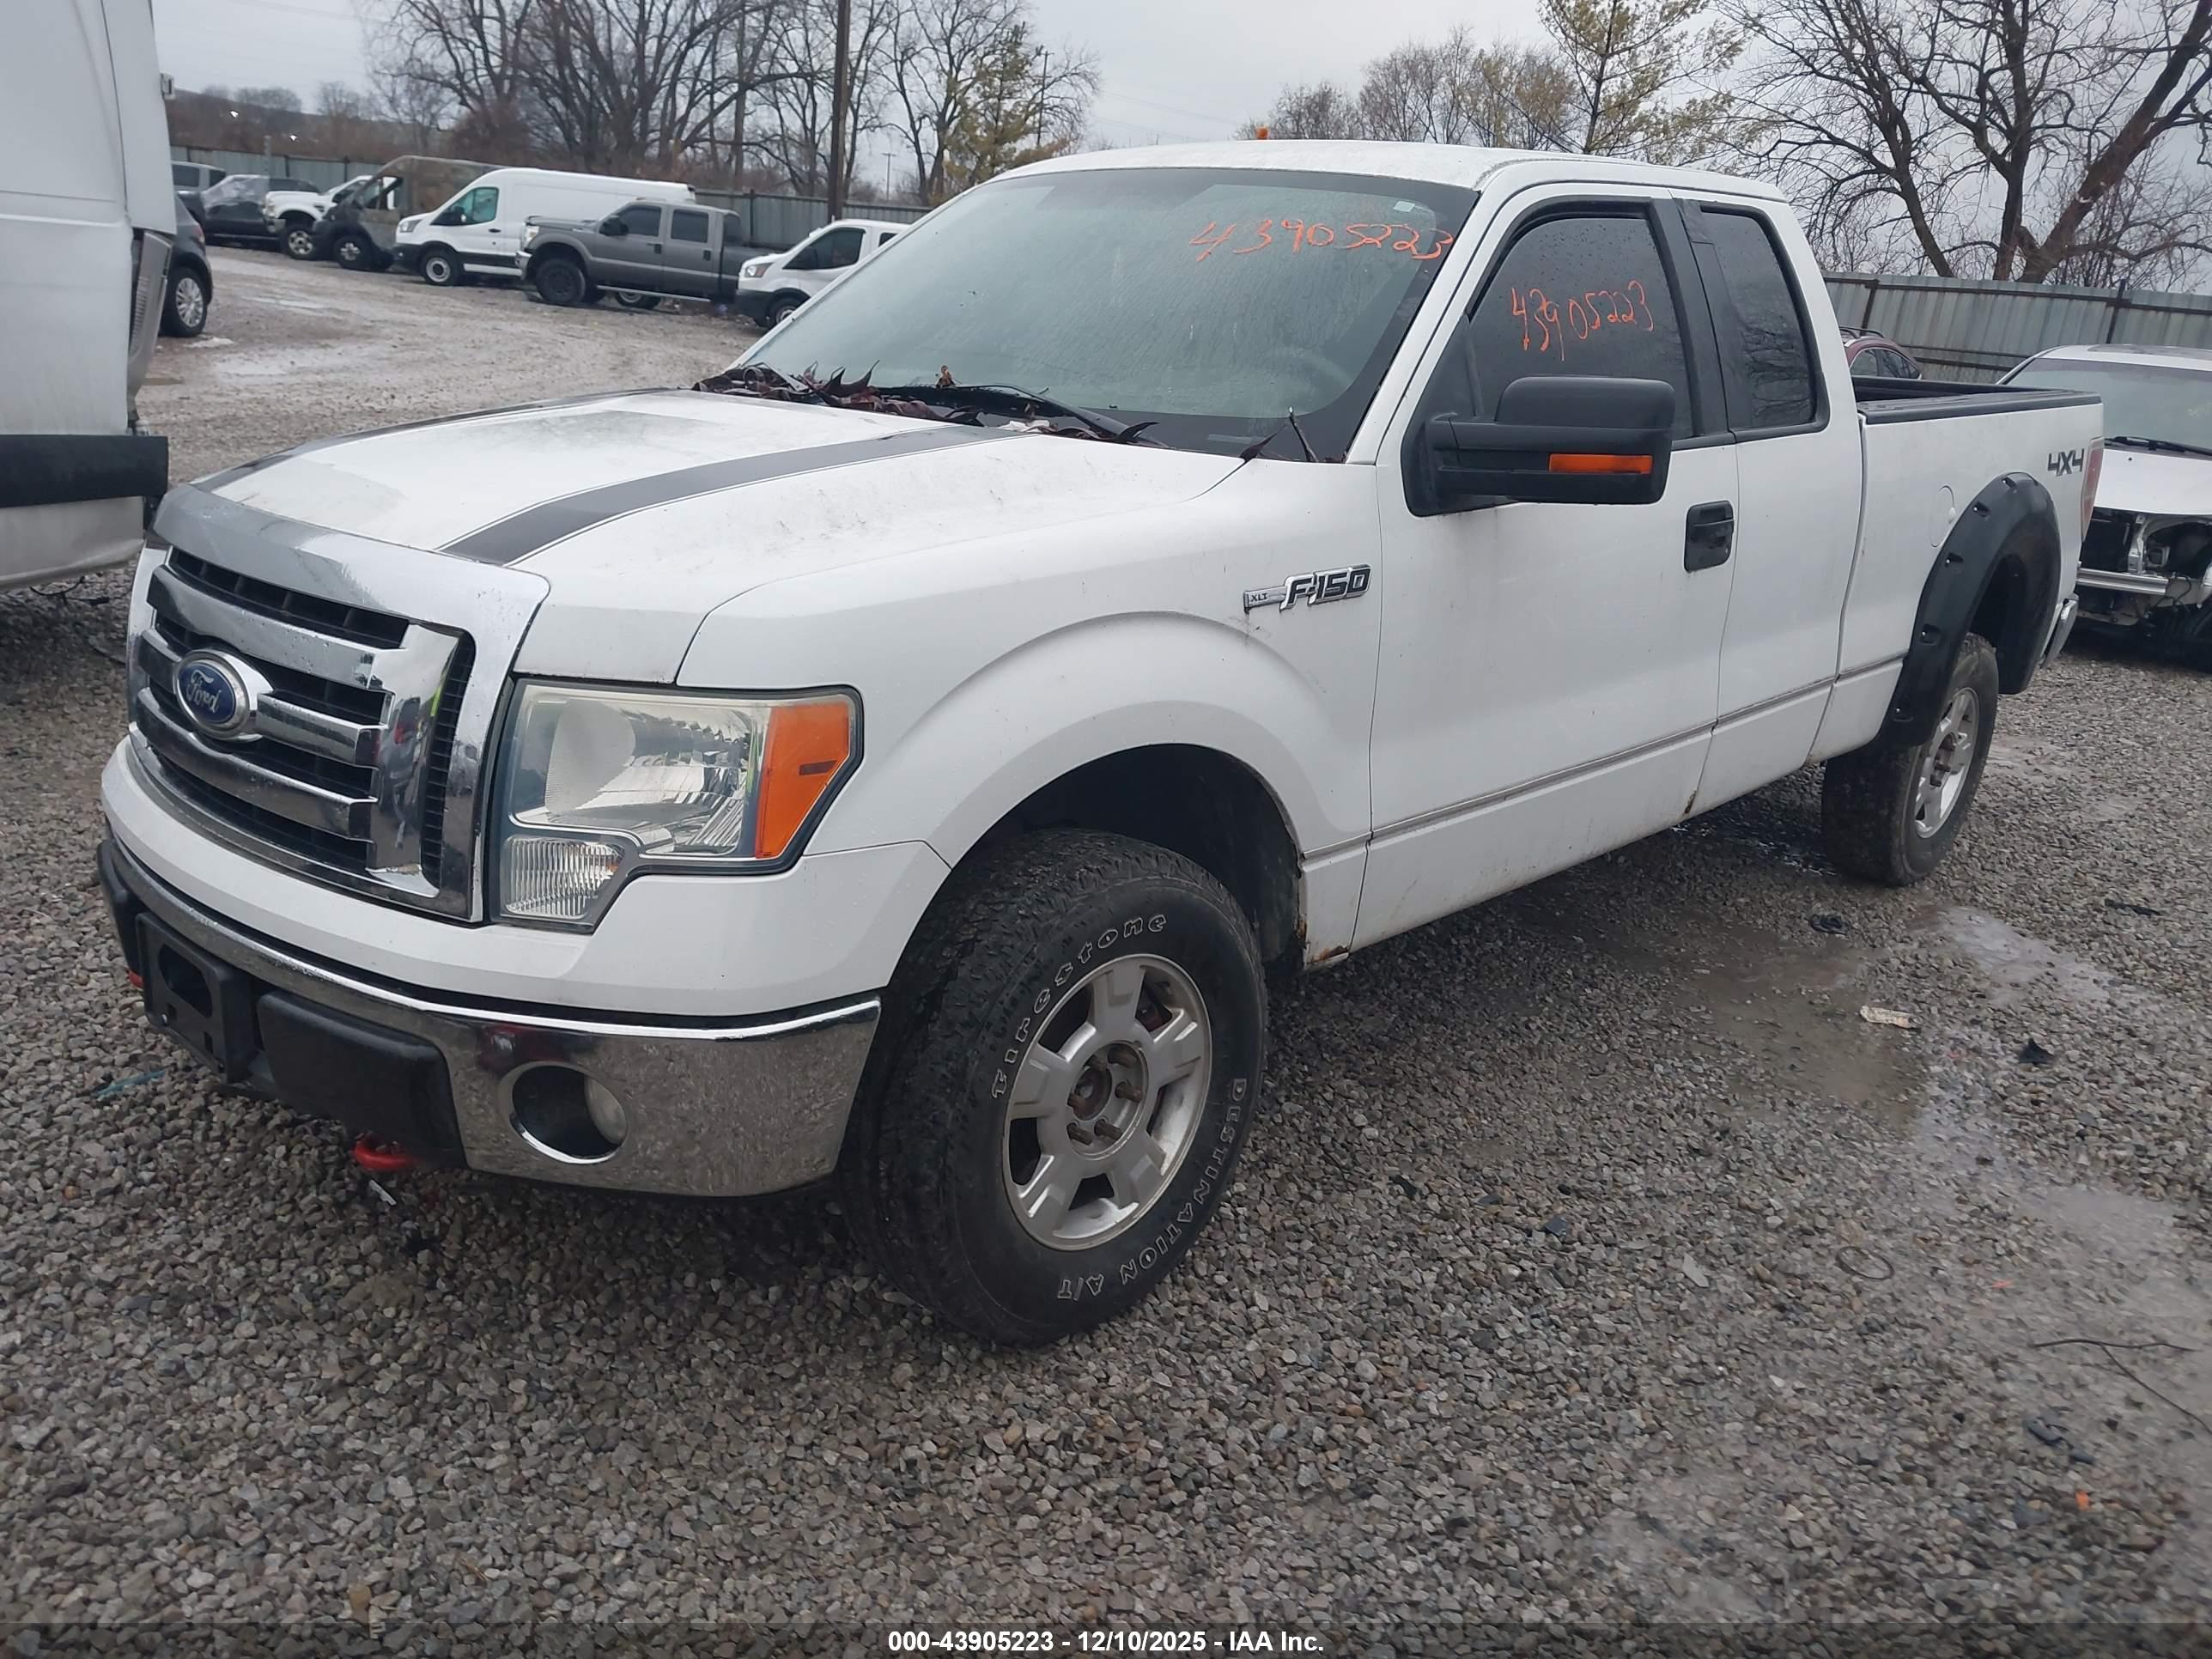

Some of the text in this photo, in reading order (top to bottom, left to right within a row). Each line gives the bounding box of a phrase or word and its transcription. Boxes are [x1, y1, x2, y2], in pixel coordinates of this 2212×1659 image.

[1188, 219, 1455, 261] 43905223
[1511, 279, 1654, 362] 43905223
[1251, 564, 1371, 610] XLT F-150
[185, 669, 222, 714] Ford
[1057, 1078, 1247, 1302] DESTINATION A/T
